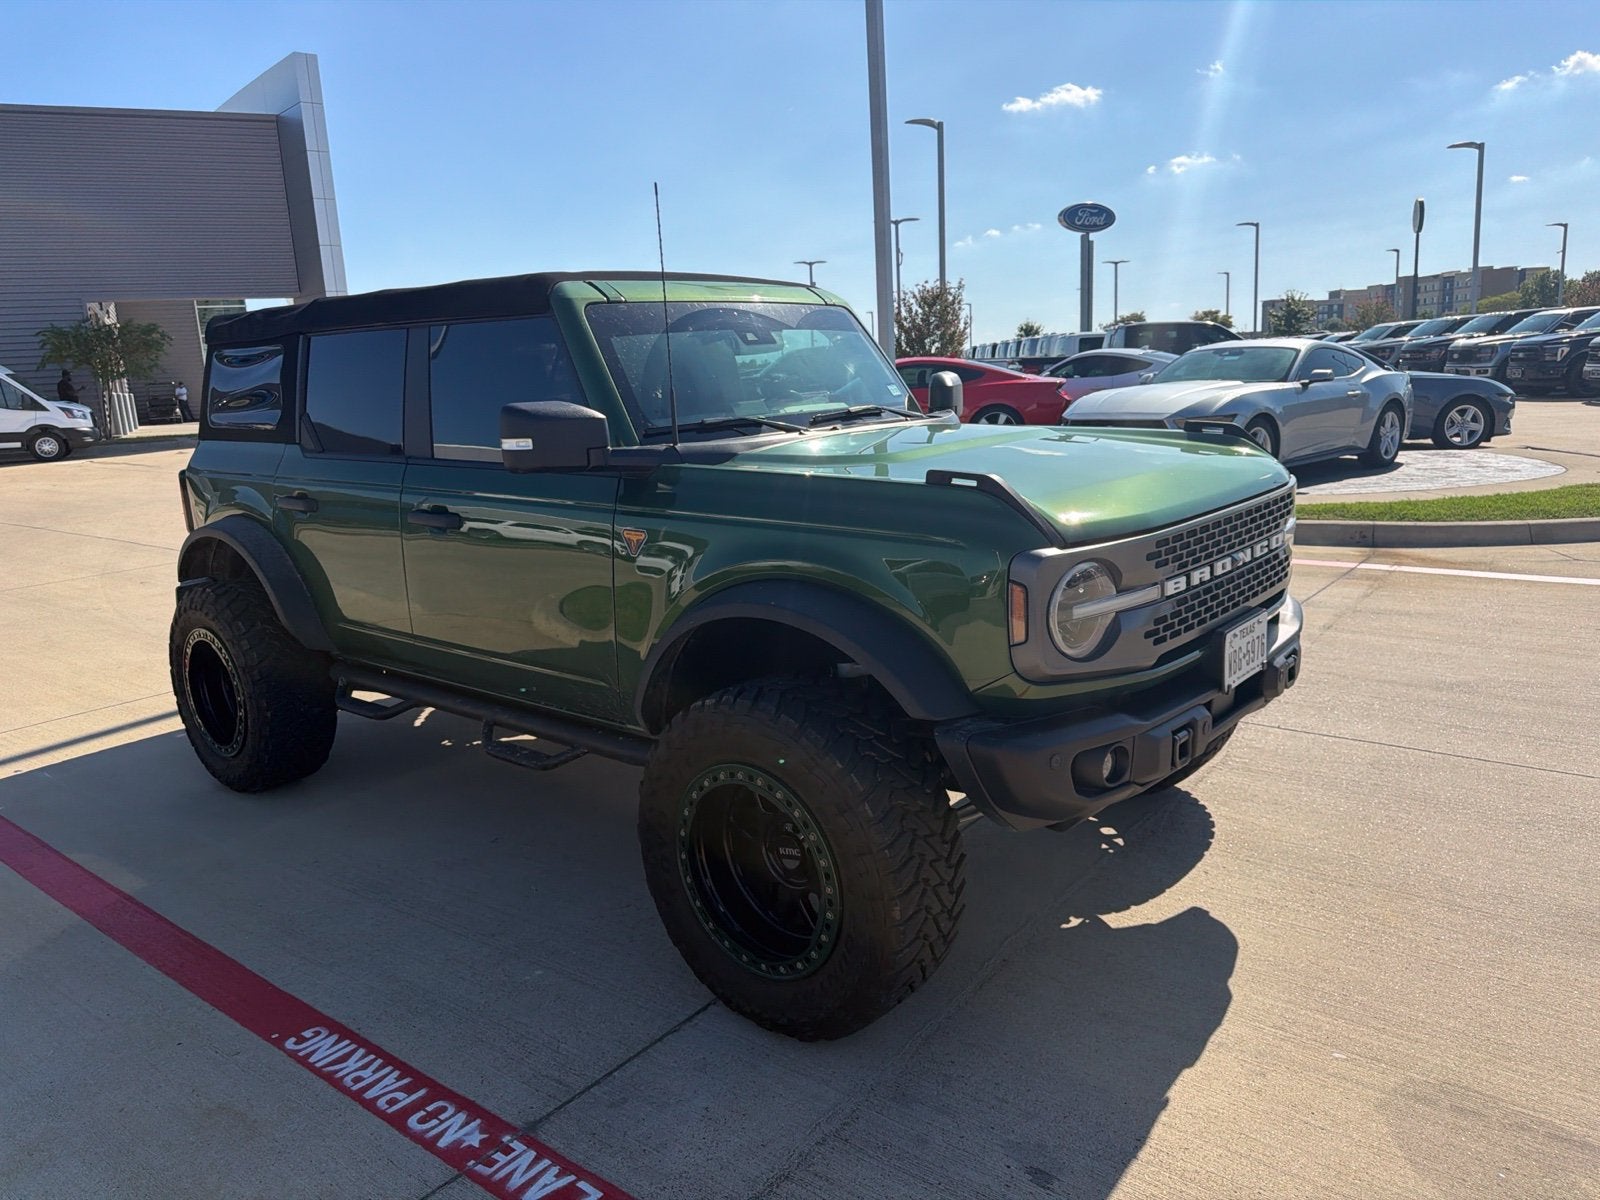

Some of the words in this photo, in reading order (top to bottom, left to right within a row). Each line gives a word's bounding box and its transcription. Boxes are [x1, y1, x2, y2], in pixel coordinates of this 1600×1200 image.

[1075, 208, 1106, 225] Ford
[1164, 532, 1284, 597] BRONCO
[1239, 621, 1256, 640] TEXAS
[779, 847, 801, 857] KMC
[284, 1026, 430, 1114] PARKING
[407, 1100, 482, 1149] NO
